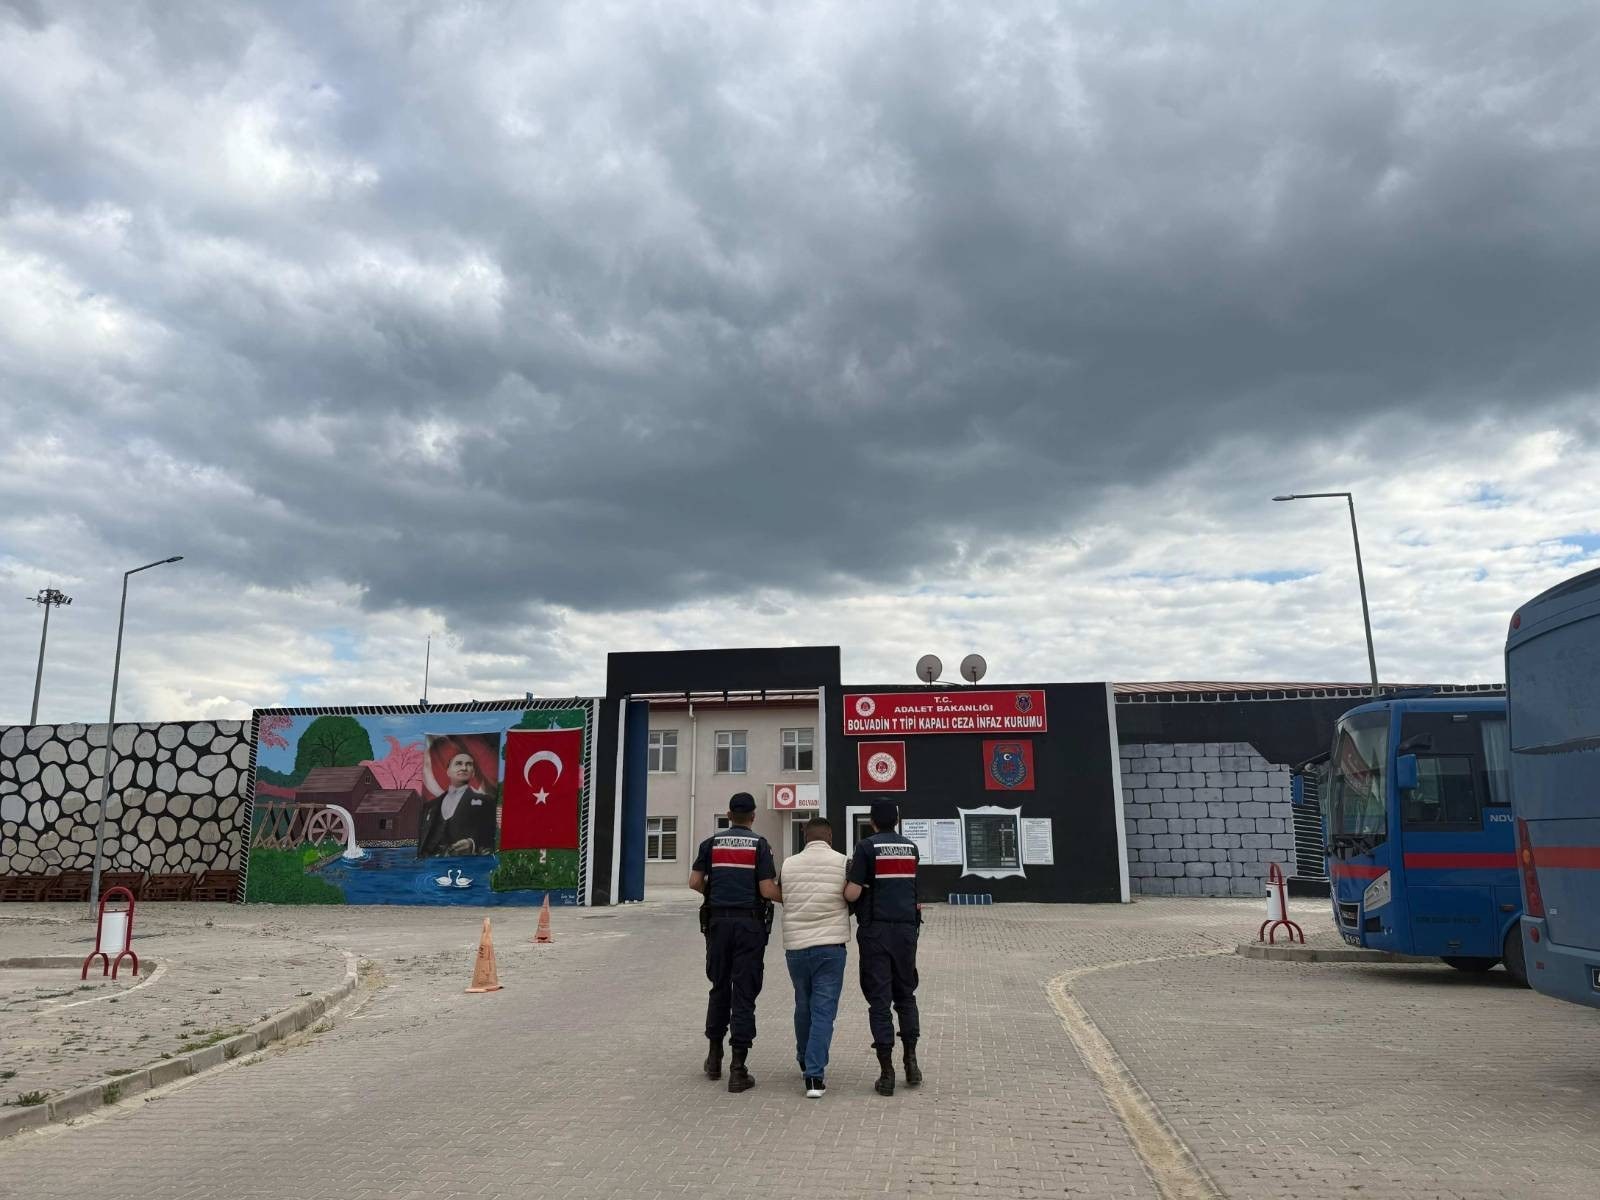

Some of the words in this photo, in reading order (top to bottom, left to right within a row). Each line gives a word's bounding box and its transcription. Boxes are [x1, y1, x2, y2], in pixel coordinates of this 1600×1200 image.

[894, 705, 934, 713] ADALET
[936, 704, 994, 712] BAKANLIĞI
[847, 716, 890, 731] BOLVADİN
[891, 718, 898, 730] T
[899, 715, 917, 730] TİPİ
[919, 717, 950, 730] KAPALI
[951, 717, 975, 729] CEZA
[976, 714, 1002, 729] İNFAZ
[1004, 716, 1043, 728] KURUMU
[717, 838, 754, 848] JANDARMA
[879, 846, 913, 857] JANDARMA
